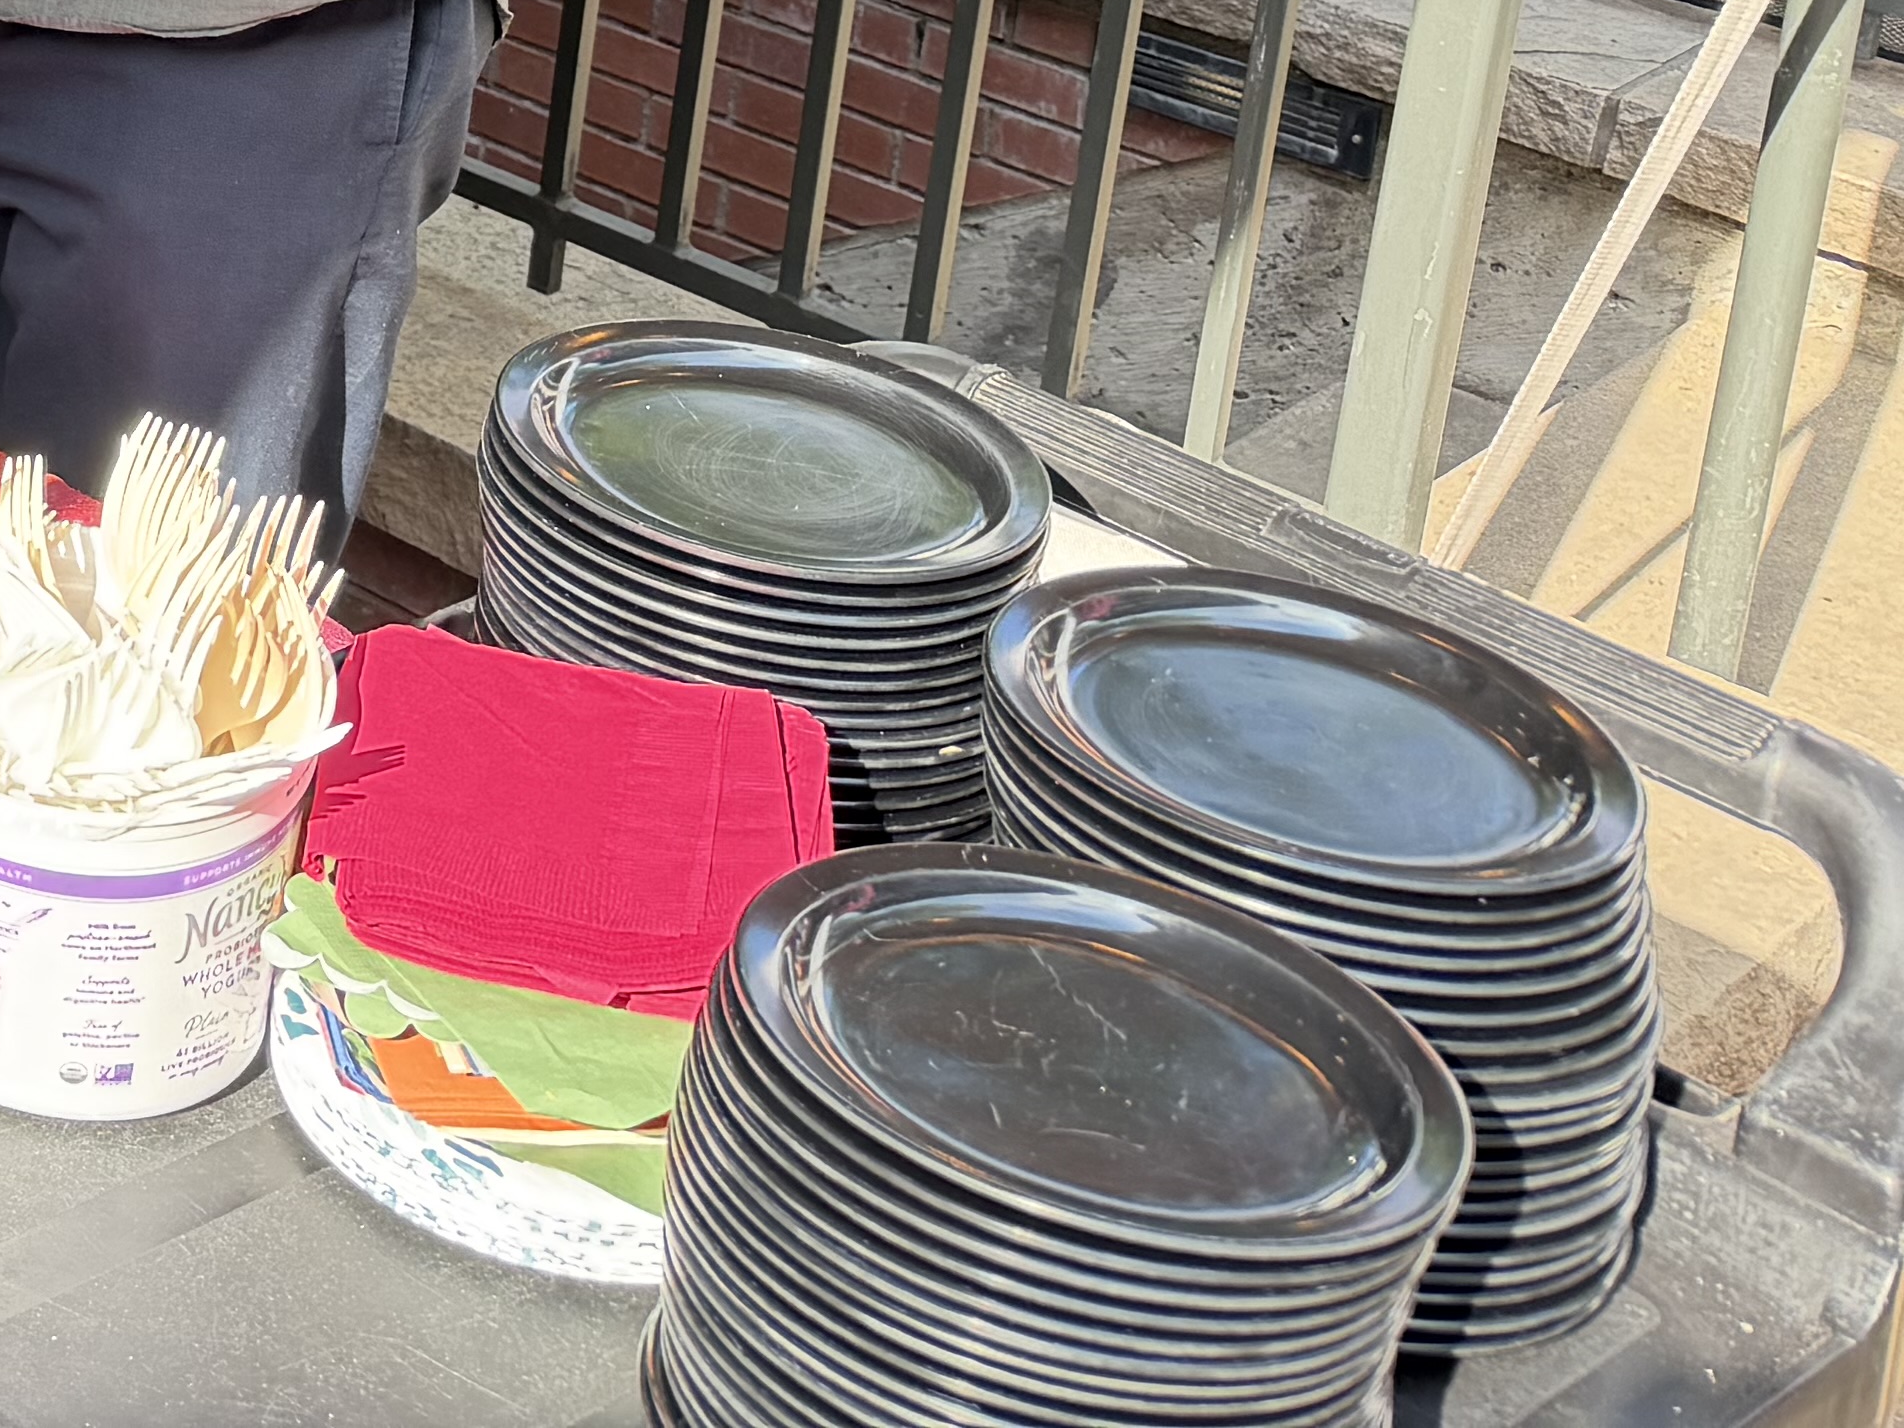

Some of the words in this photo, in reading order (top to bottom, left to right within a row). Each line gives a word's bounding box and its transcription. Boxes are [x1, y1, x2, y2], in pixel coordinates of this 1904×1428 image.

[183, 857, 242, 887] SUPPORTS
[182, 952, 243, 988] WHOLE
[184, 1010, 230, 1039] Plain
